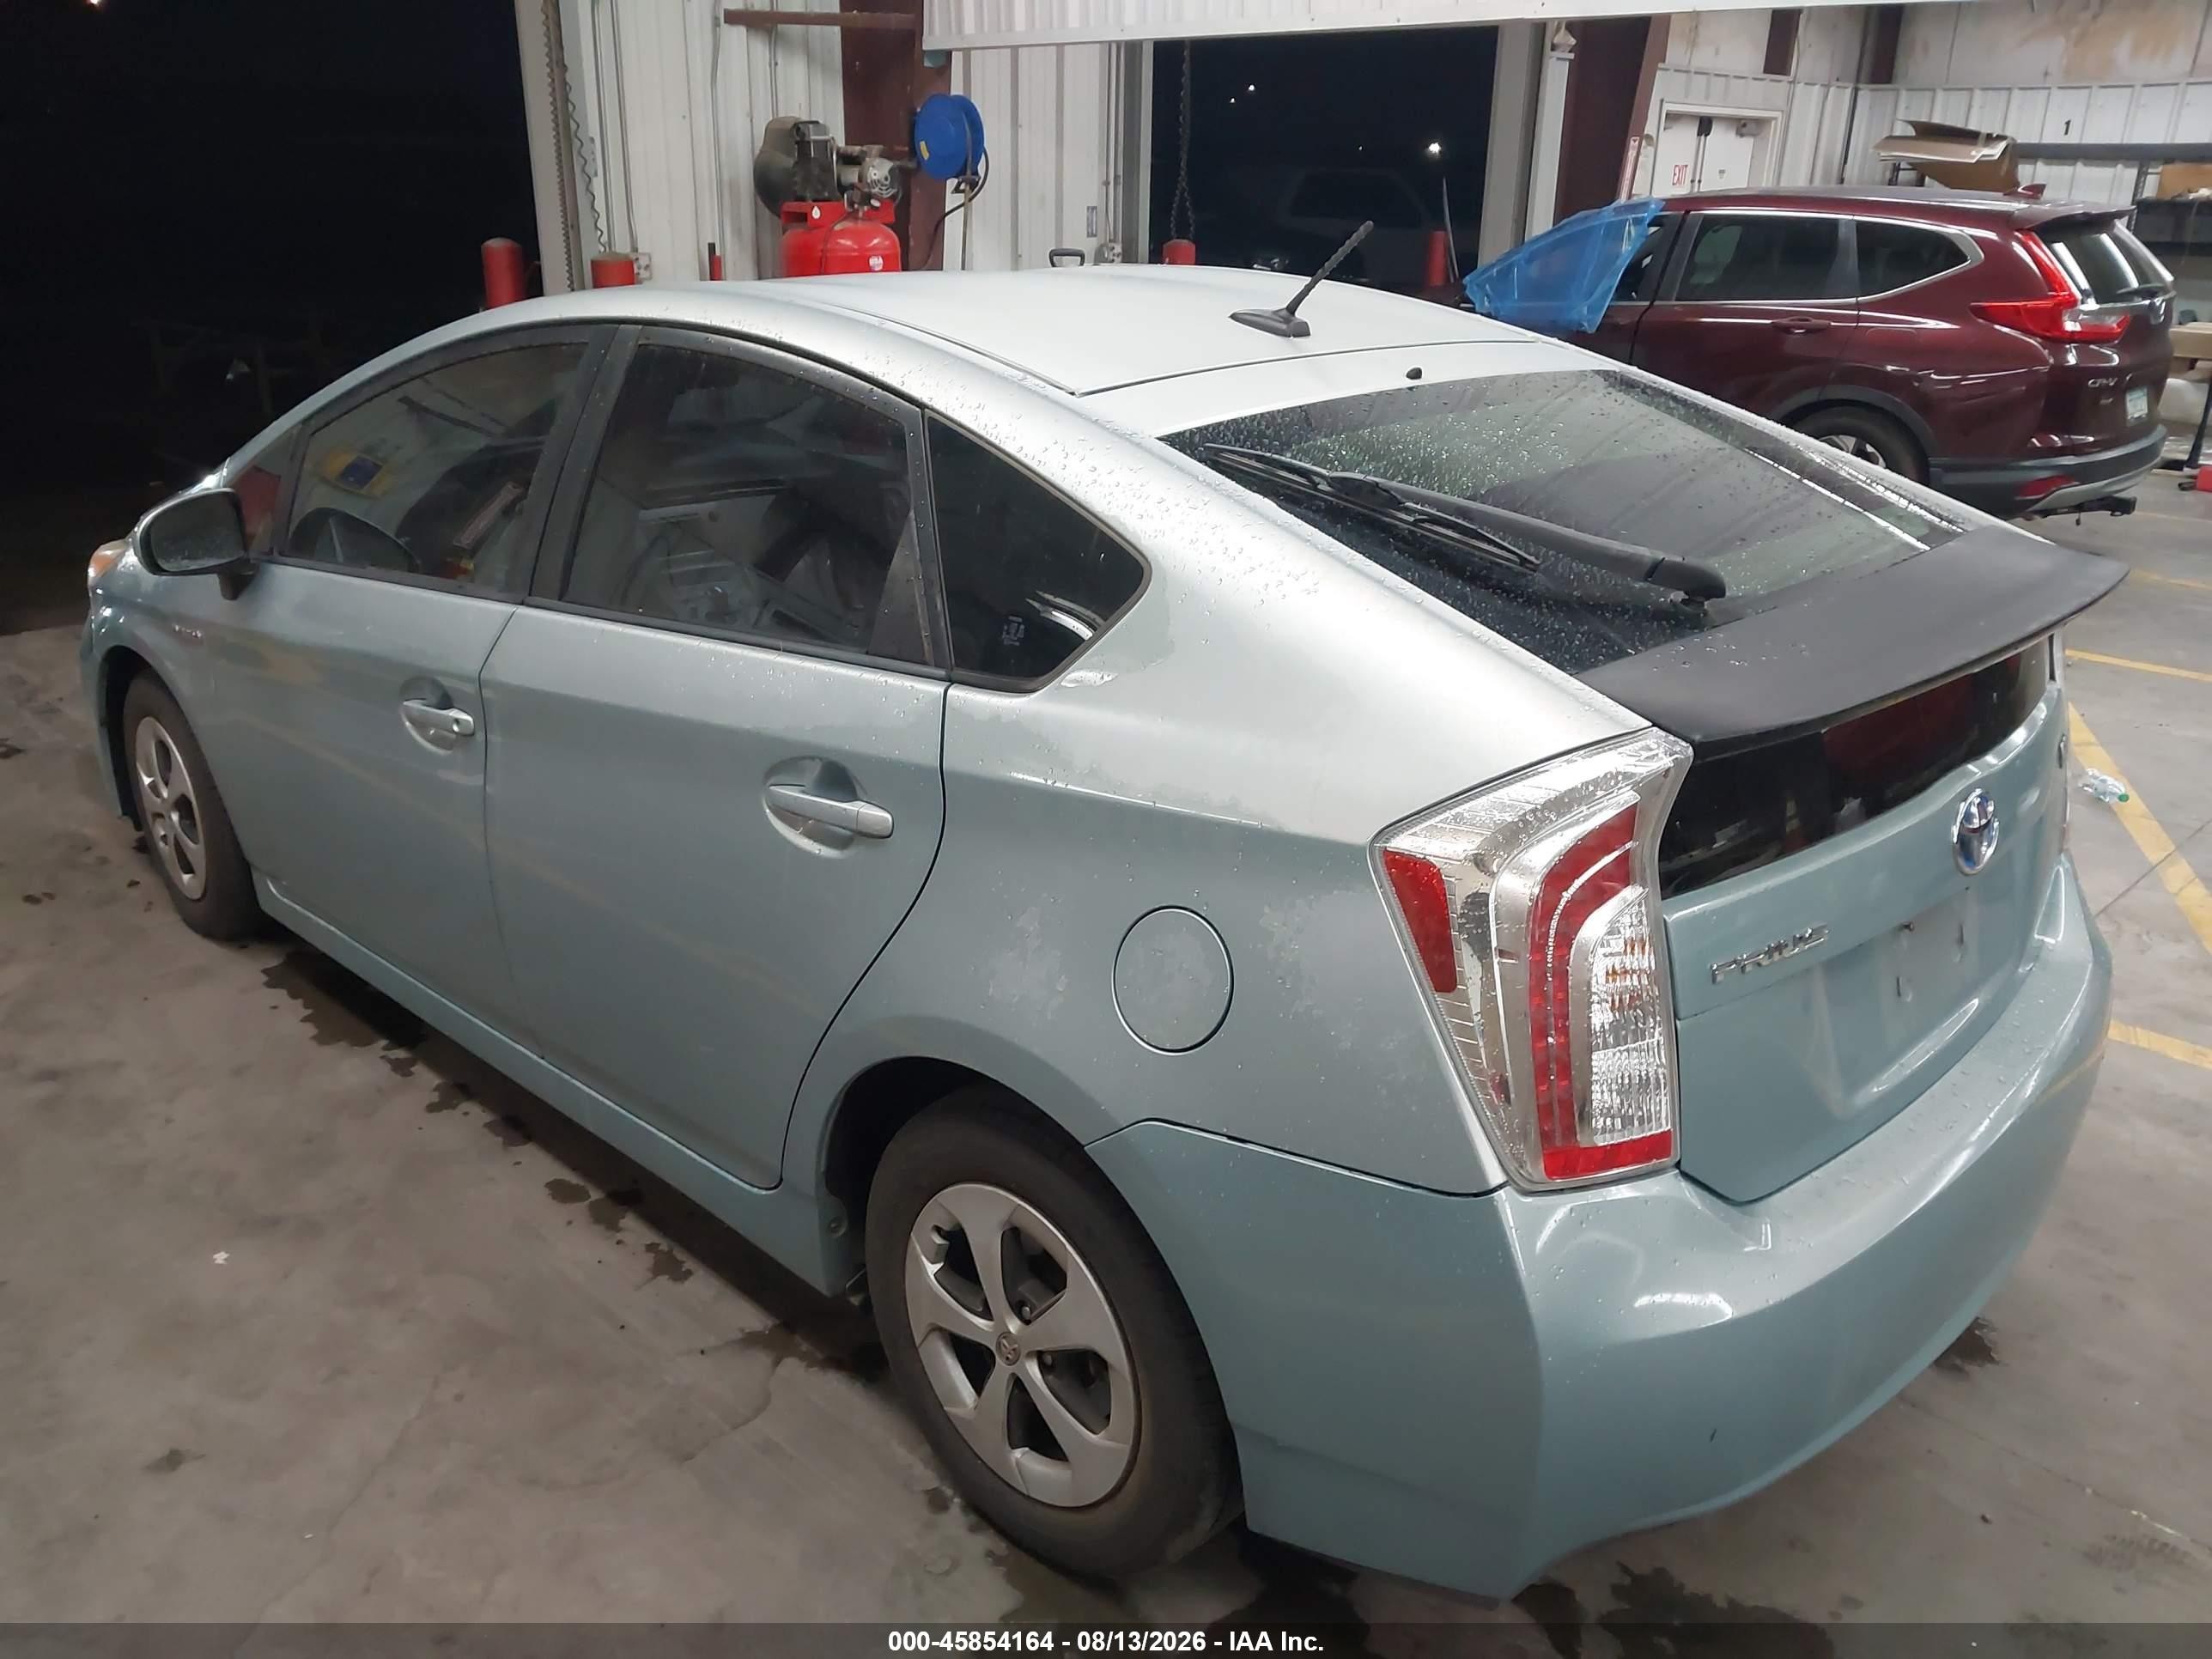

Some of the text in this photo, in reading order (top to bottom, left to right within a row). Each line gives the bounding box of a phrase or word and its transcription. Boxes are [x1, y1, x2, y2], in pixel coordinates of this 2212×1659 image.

[2063, 119, 2072, 137] 1
[1672, 164, 1689, 186] EXIT
[1710, 923, 1828, 985] PRIUS
